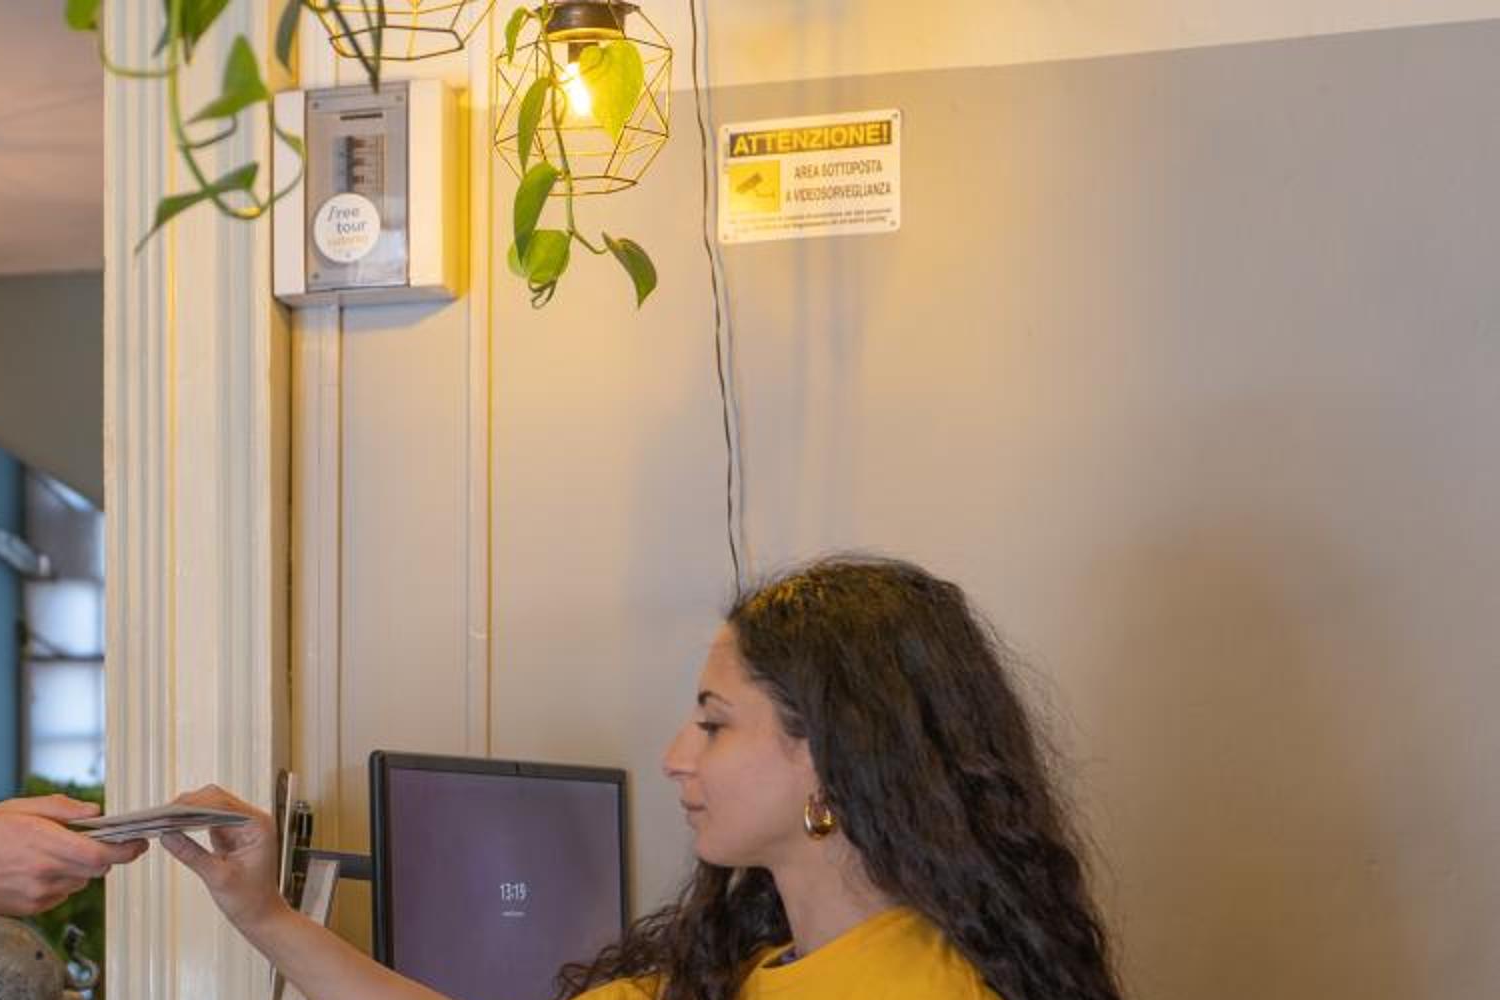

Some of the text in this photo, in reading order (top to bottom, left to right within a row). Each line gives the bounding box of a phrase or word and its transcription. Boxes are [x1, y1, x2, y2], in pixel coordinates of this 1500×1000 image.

[733, 122, 890, 156] ATTENZIONE!
[794, 159, 883, 179] AREA SOTTOPOSTA
[336, 220, 366, 236] tour
